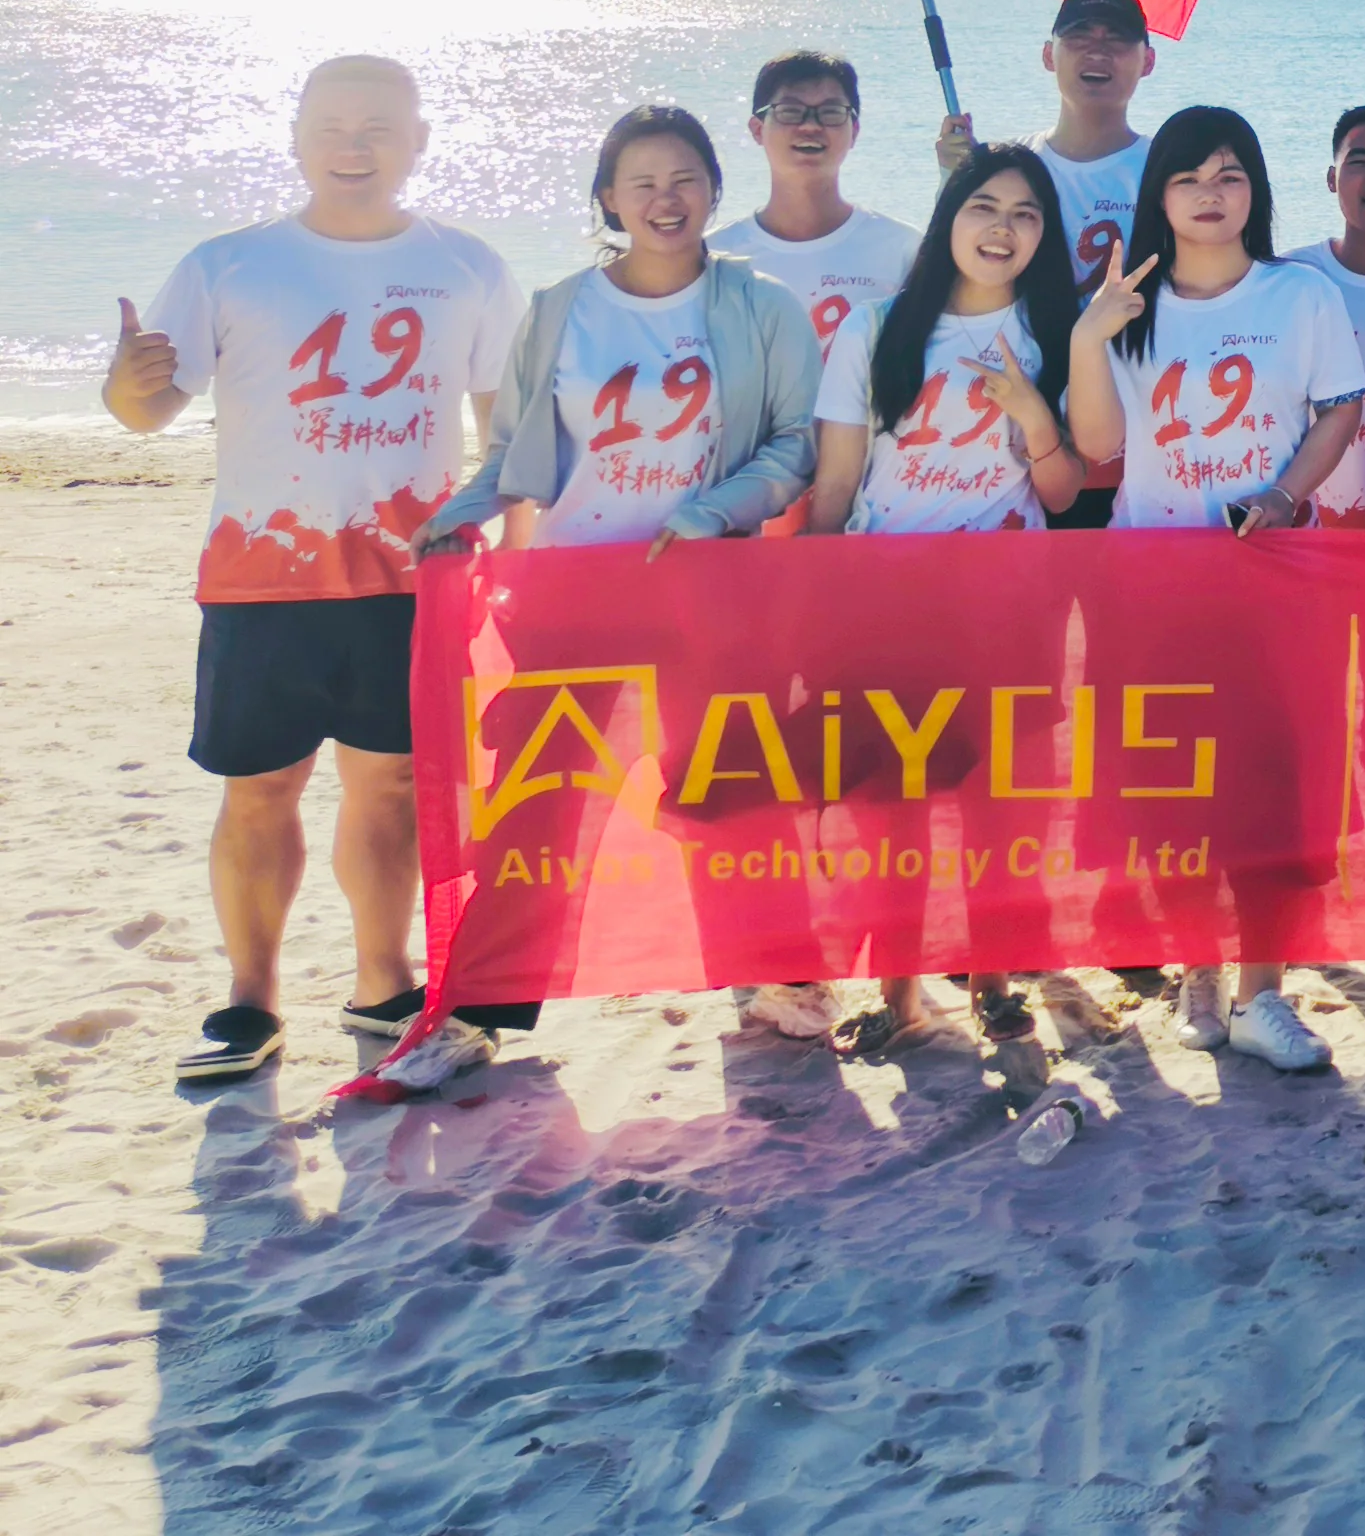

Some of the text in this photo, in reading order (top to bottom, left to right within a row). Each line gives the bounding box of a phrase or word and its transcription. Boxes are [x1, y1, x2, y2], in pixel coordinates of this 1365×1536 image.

[1077, 218, 1125, 294] 9
[288, 307, 425, 406] 19
[811, 294, 853, 364] 9
[294, 406, 436, 455] 深耕细作
[589, 354, 713, 452] 19
[1151, 352, 1277, 448] 19 周年
[895, 452, 1006, 498] 深耕细作
[1165, 443, 1273, 490] 深耕细作
[677, 684, 1217, 805] AiYOS
[680, 837, 992, 889] Technology
[1124, 835, 1211, 878] Ltd
